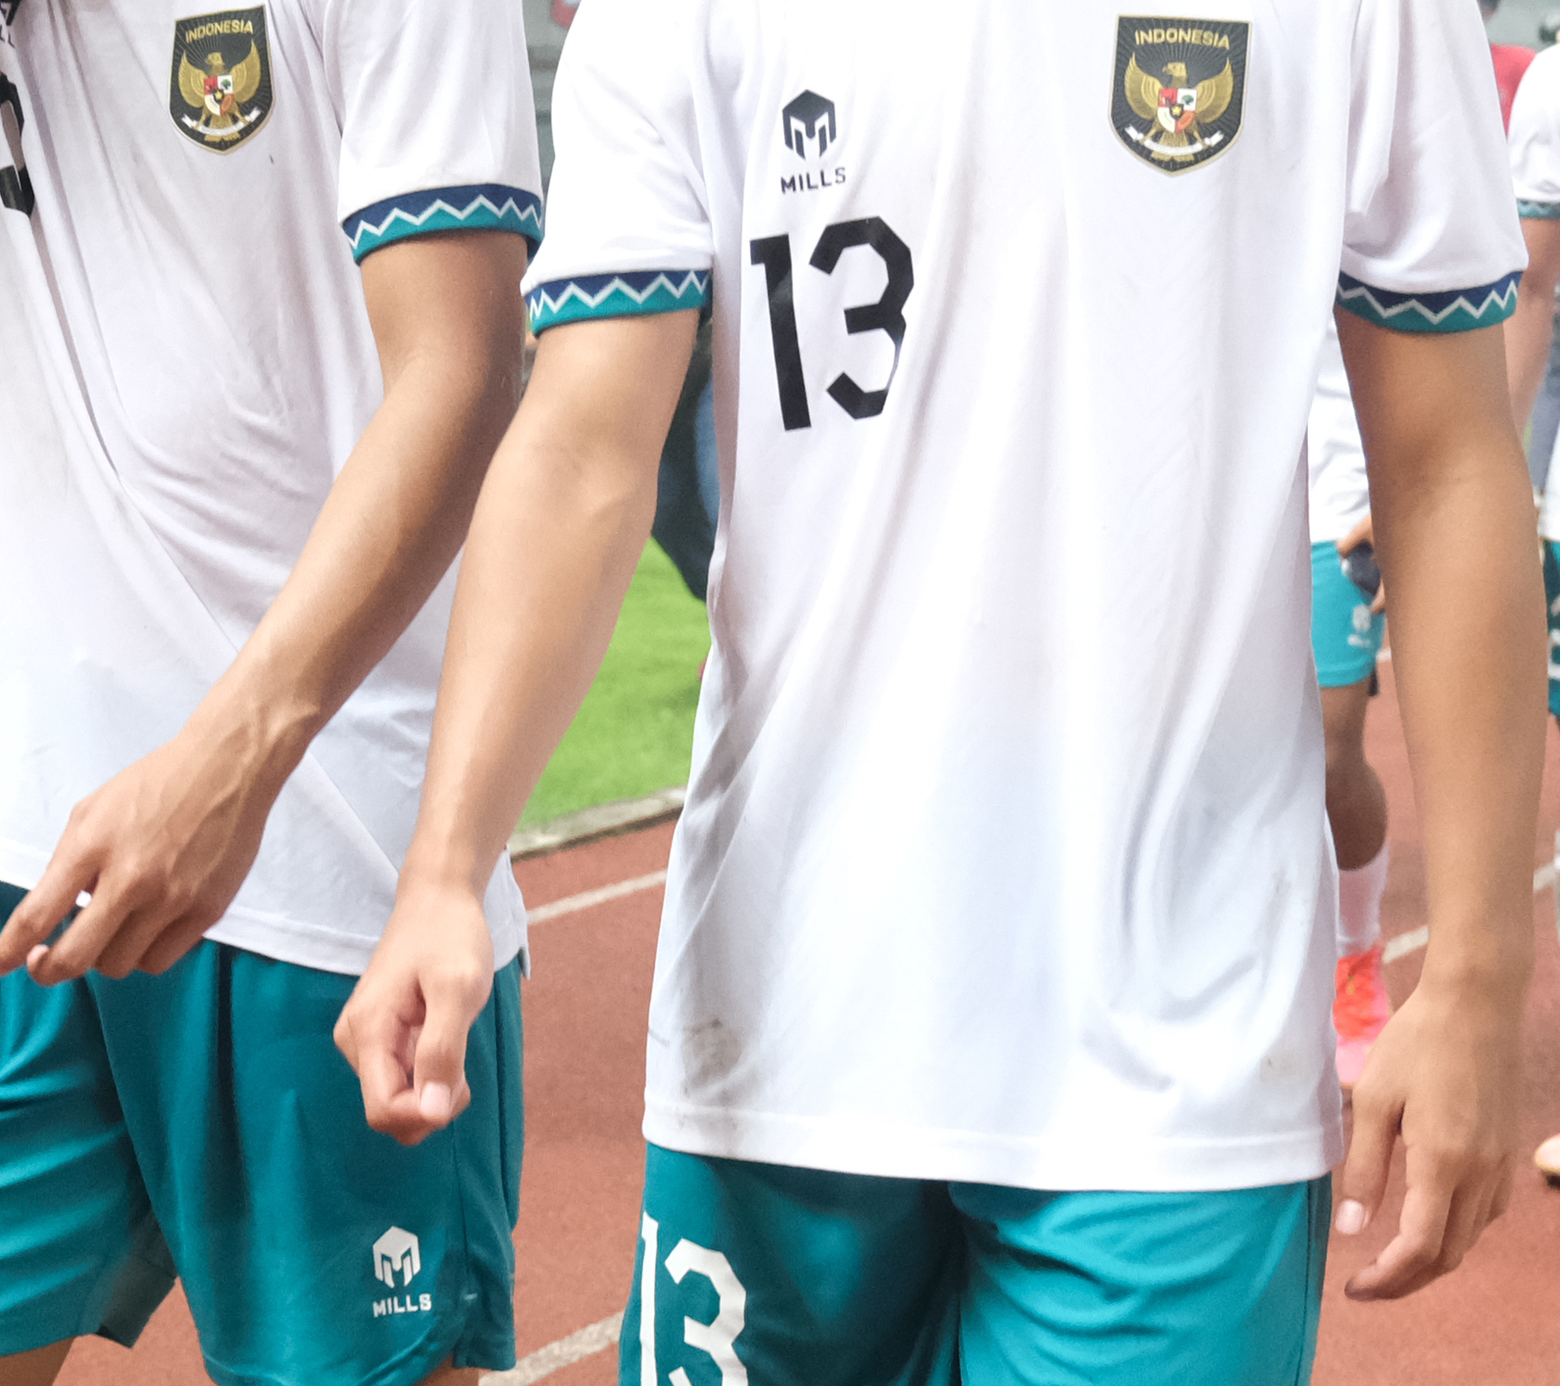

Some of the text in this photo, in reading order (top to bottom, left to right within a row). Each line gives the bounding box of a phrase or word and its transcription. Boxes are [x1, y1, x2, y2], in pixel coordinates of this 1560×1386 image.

[185, 19, 254, 44] INDONESIA
[1134, 28, 1230, 50] INDONESIA
[780, 167, 847, 194] MILLS
[748, 216, 915, 432] 13
[373, 1293, 432, 1318] MILLS
